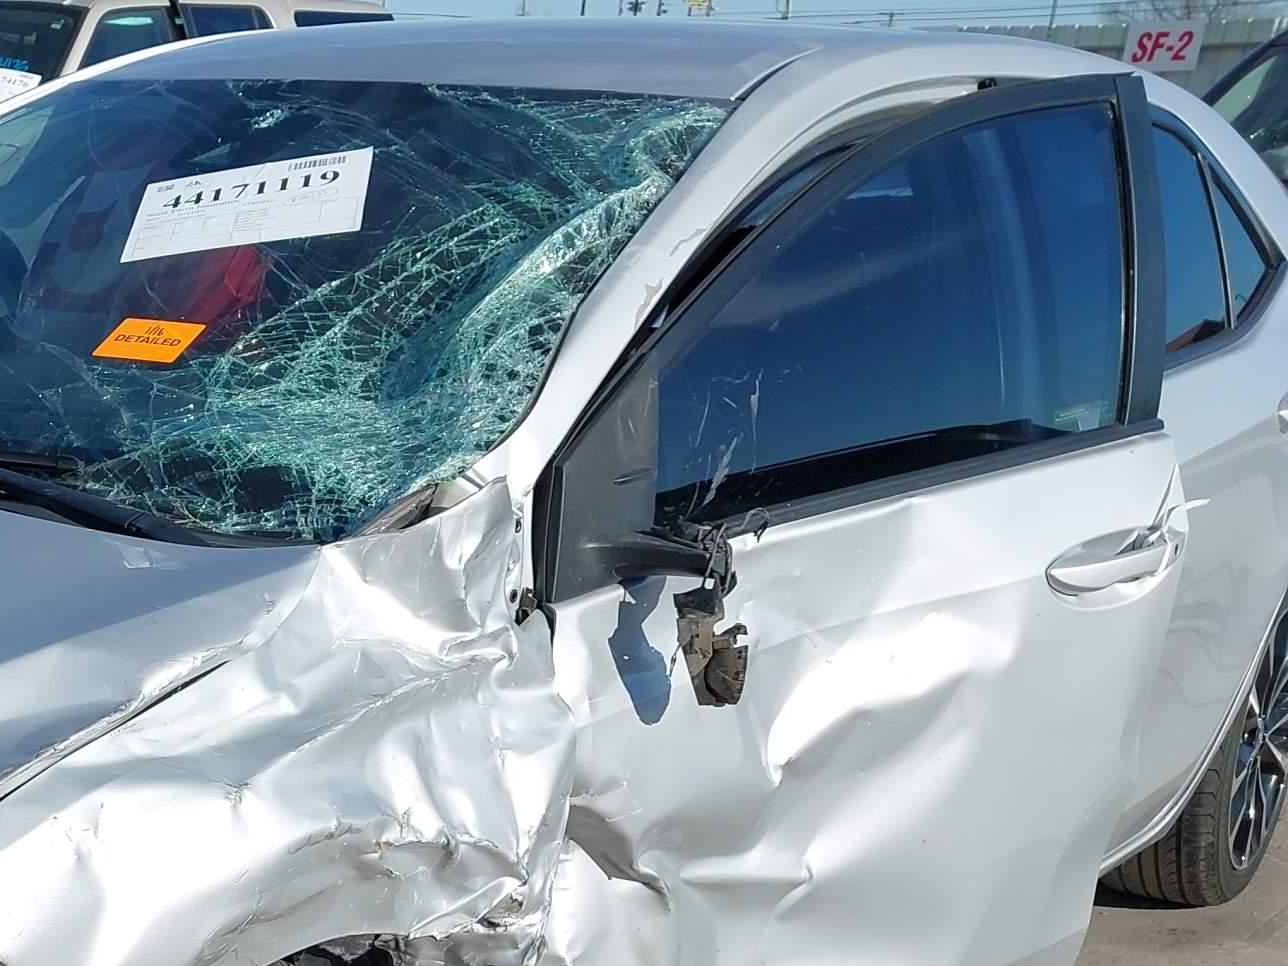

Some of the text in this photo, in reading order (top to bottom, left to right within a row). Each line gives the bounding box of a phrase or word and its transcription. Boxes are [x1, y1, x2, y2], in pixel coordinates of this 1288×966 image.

[1131, 31, 1194, 62] SF-2
[162, 170, 340, 209] 44171119
[114, 334, 182, 347] DETAILED
